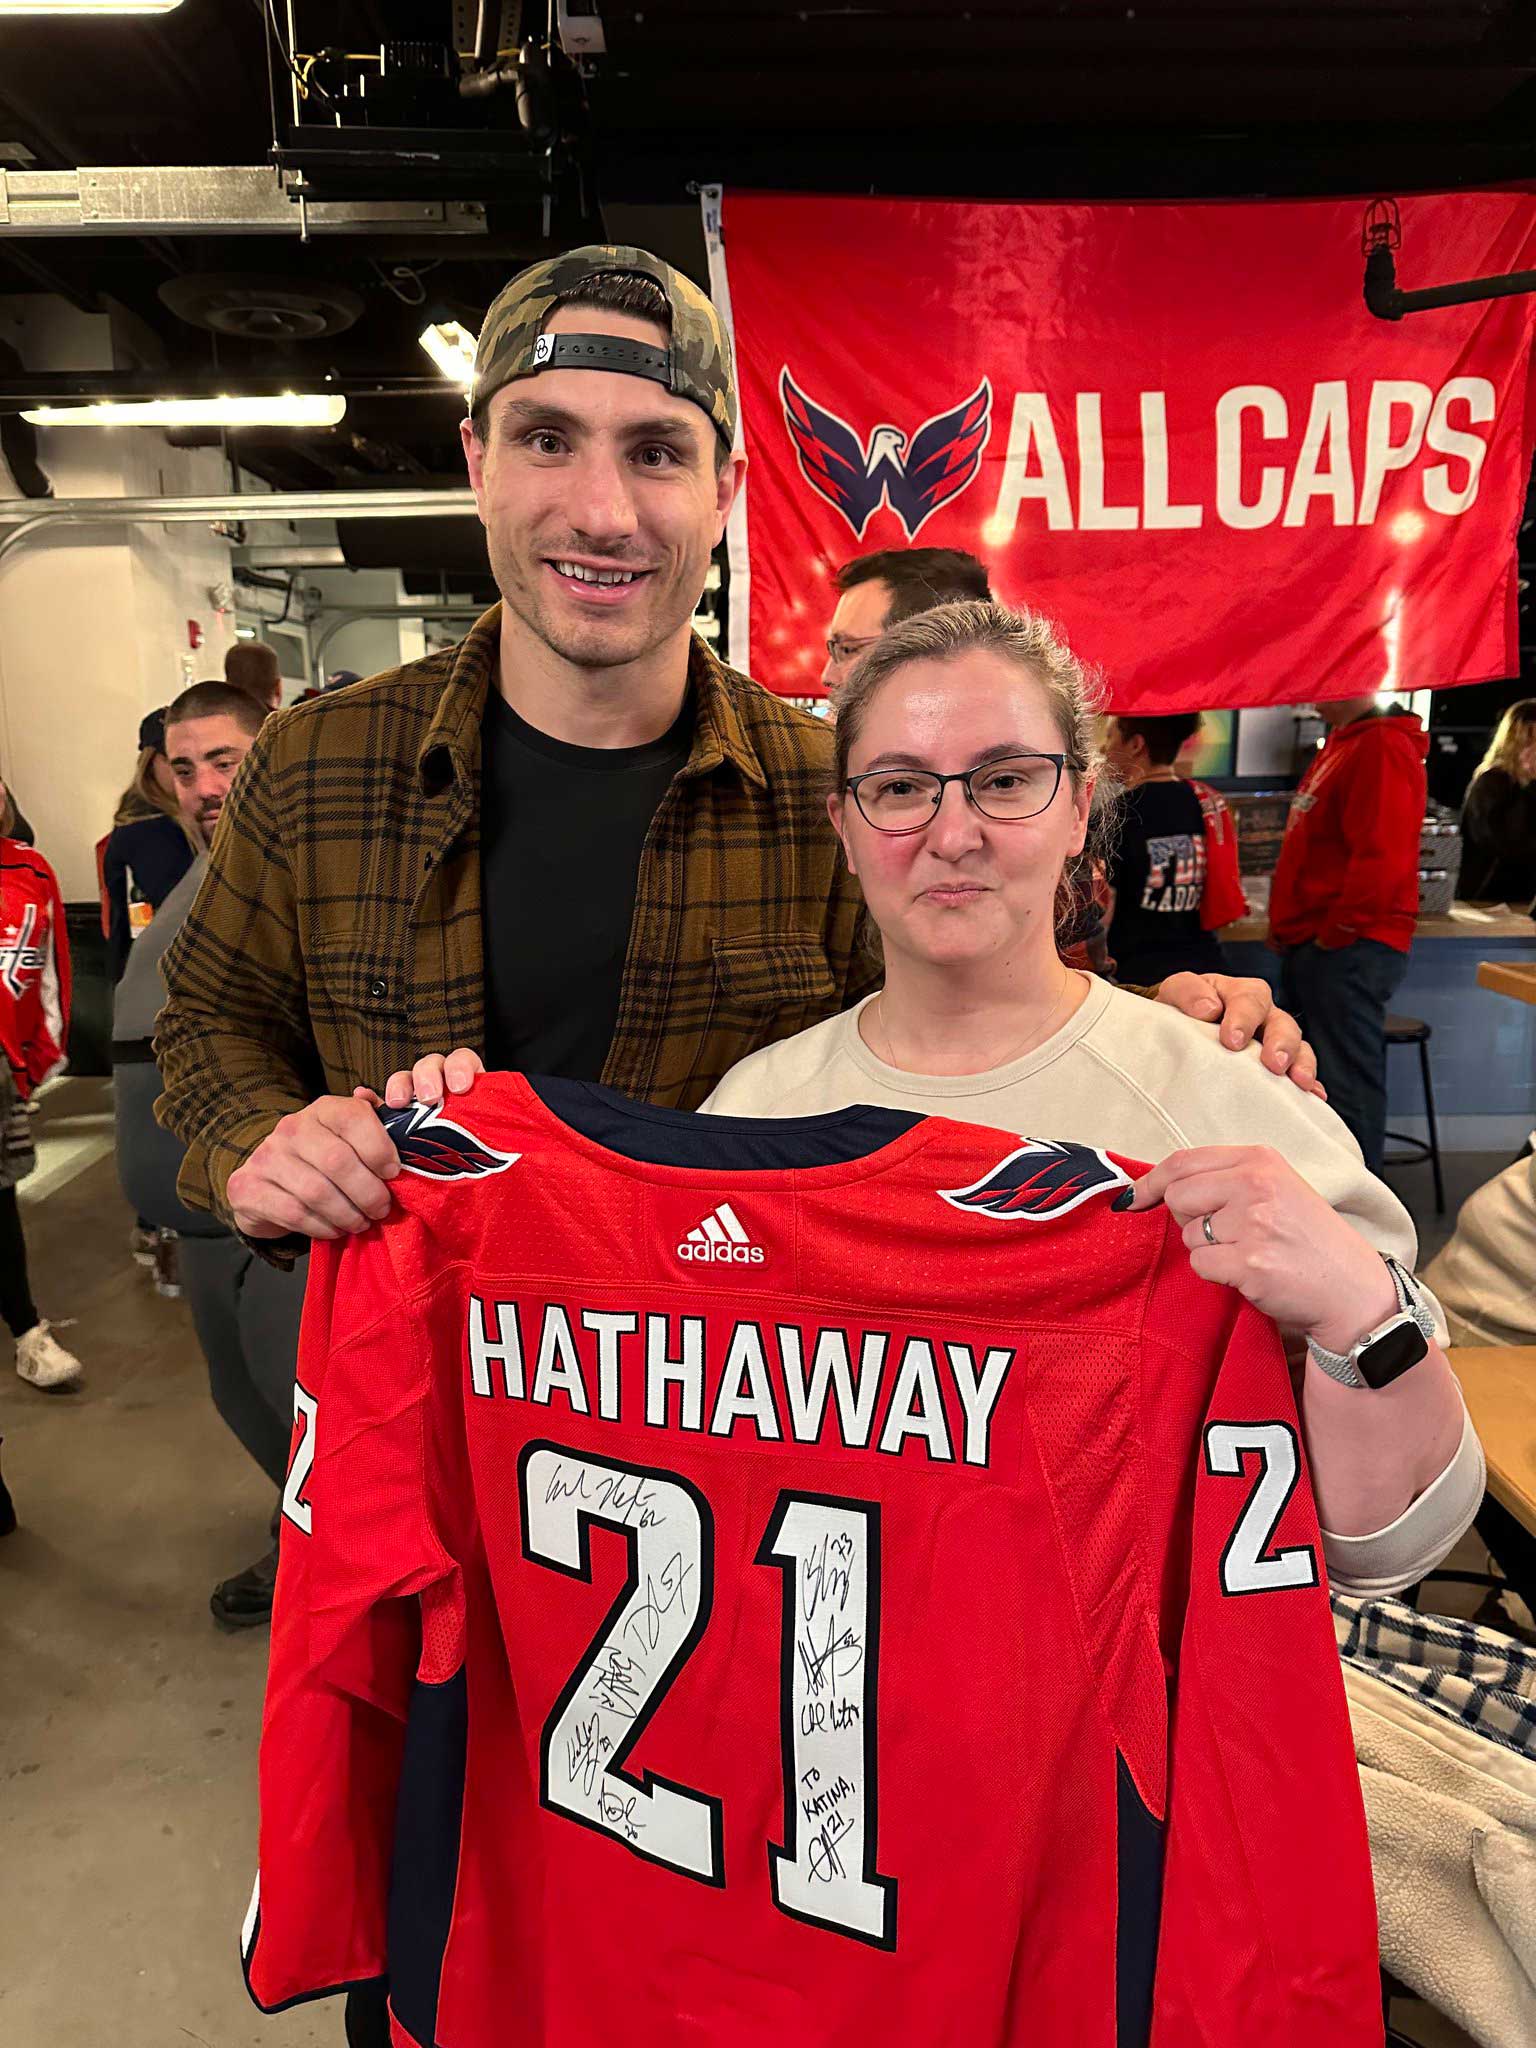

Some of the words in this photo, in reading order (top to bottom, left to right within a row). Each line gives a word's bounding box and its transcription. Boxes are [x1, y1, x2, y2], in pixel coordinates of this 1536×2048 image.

[996, 391, 1203, 531] ALL
[1215, 376, 1496, 528] CAPS
[1140, 884, 1203, 912] LADD
[677, 1239, 765, 1264] adidas
[468, 1294, 1015, 1469] HATHAWAY
[1203, 1420, 1320, 1597] 2
[517, 1438, 899, 1954] 21
[801, 1766, 821, 1790] TO
